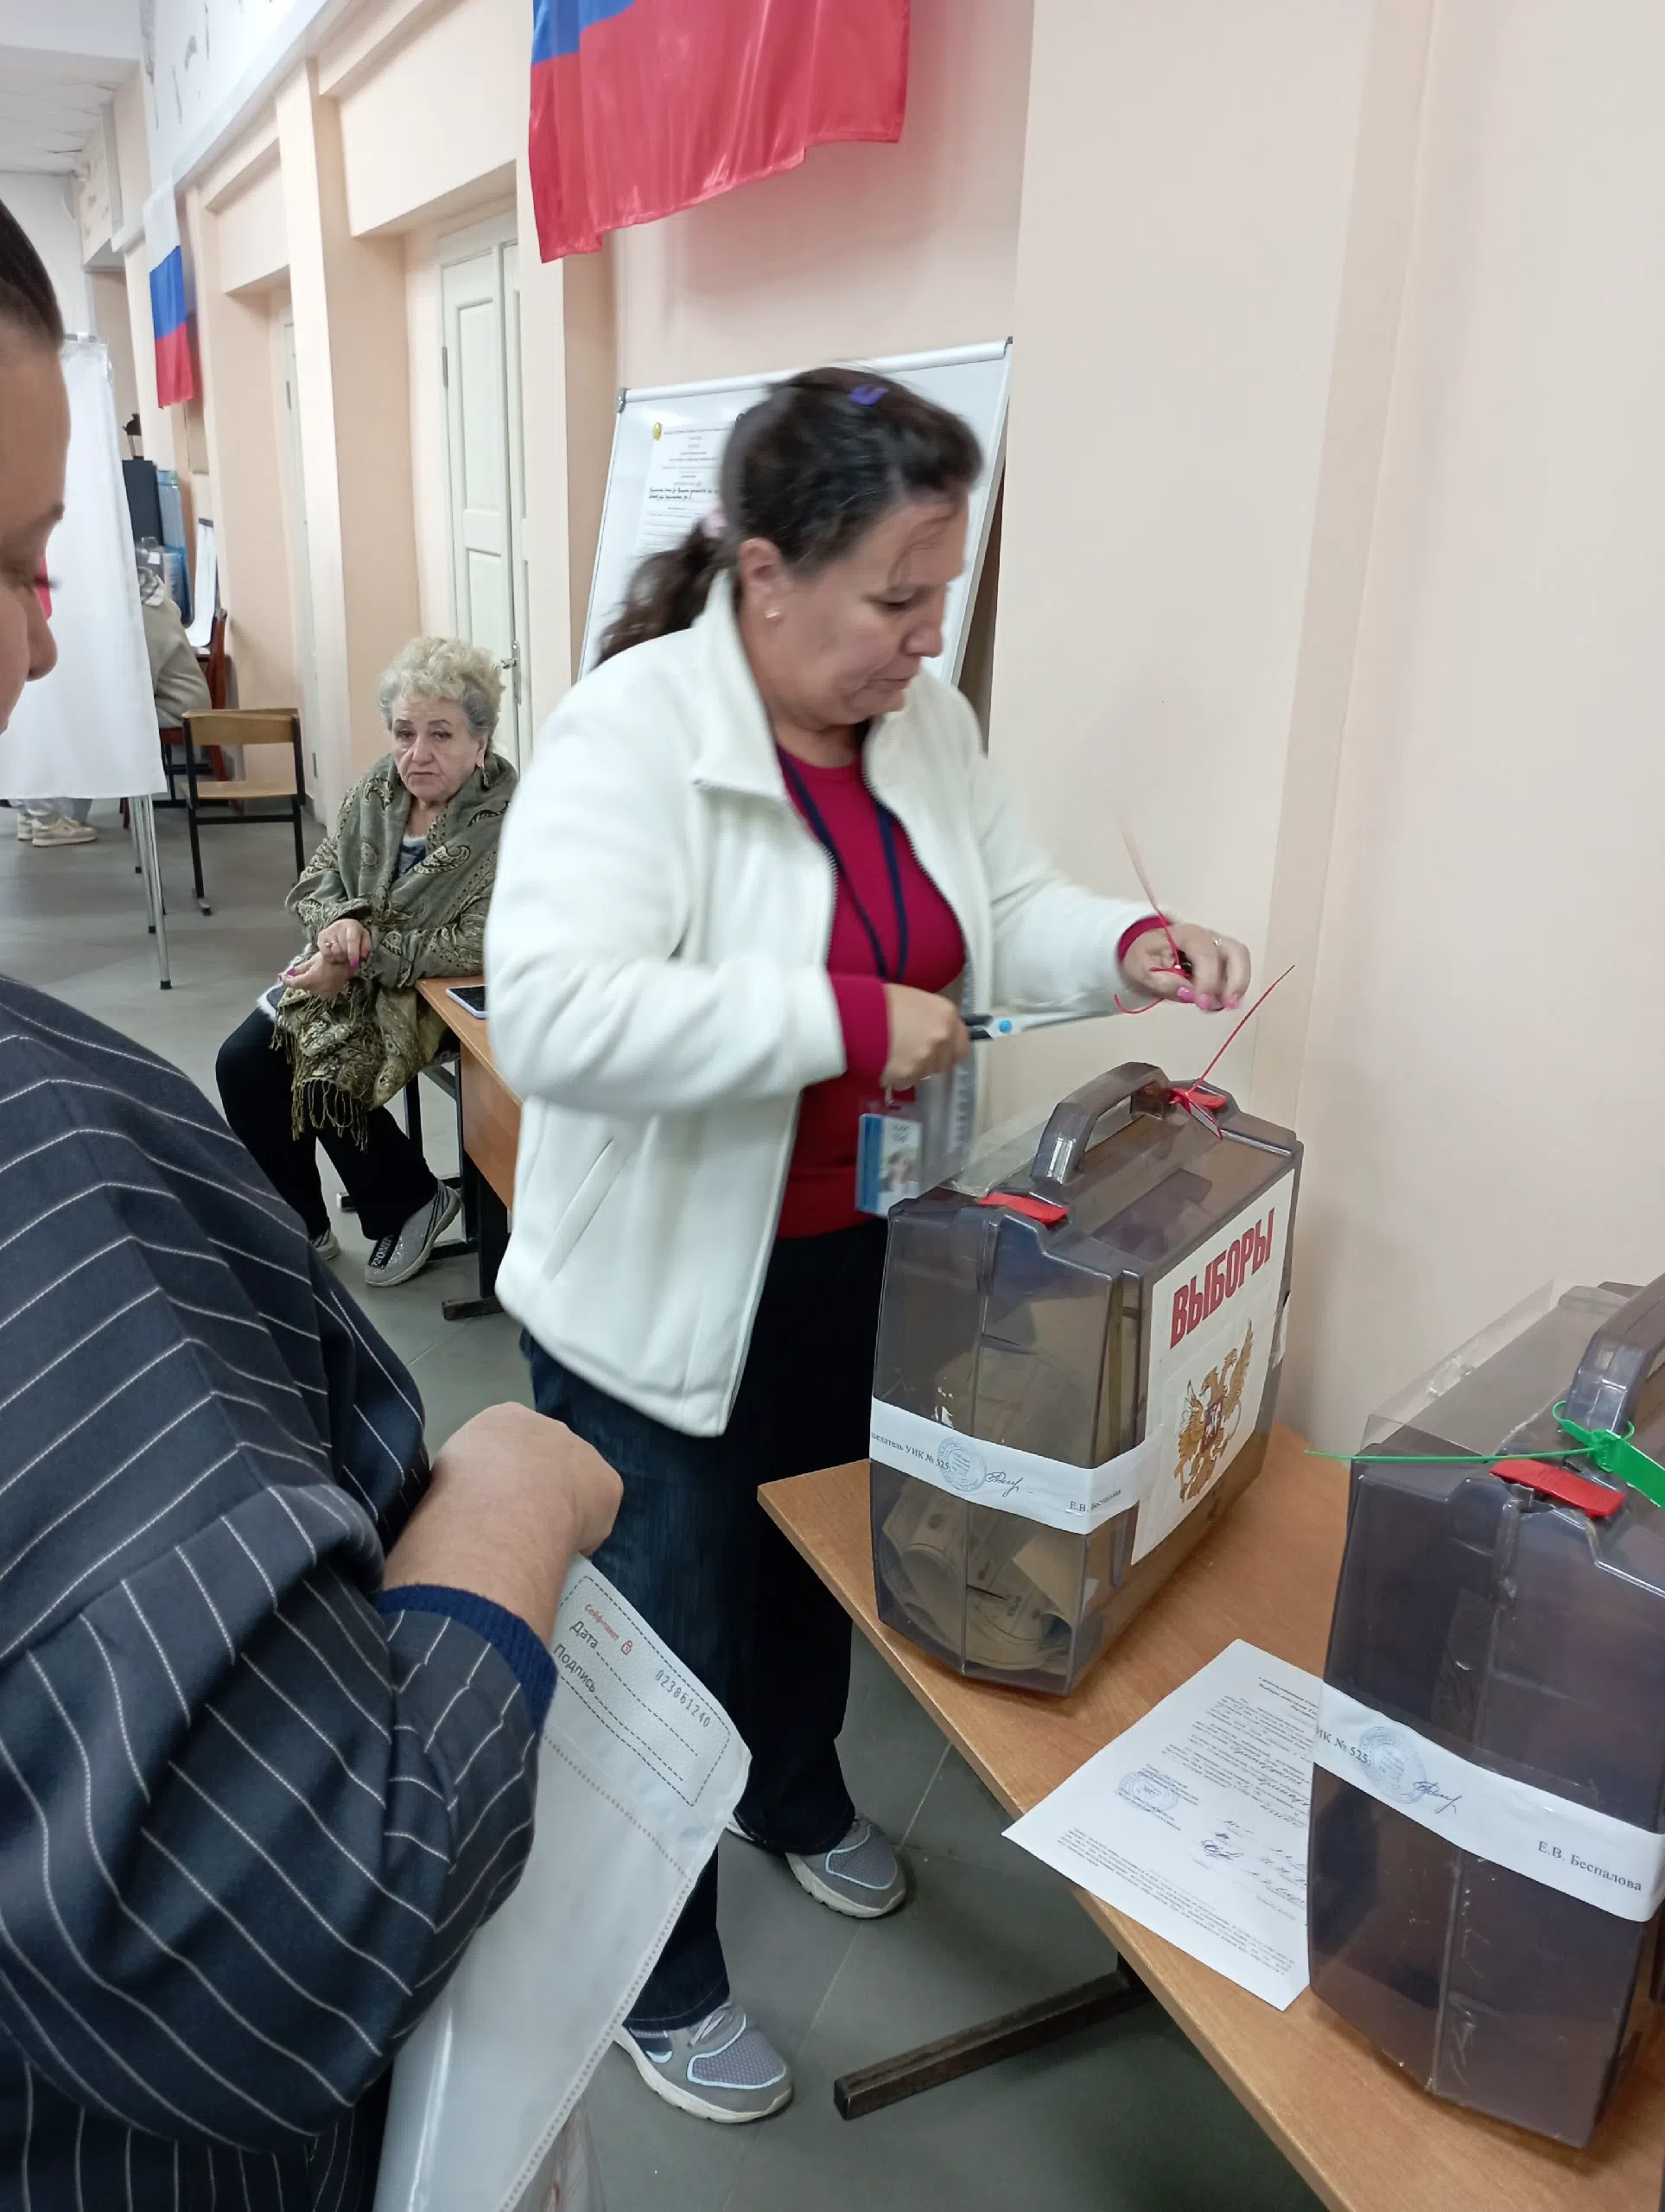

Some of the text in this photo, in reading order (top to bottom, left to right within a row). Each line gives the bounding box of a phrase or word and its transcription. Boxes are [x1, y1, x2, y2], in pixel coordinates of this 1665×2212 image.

[1170, 1207, 1274, 1350] ВЫБОРЫ
[905, 1445, 925, 1459] УИК
[569, 1620, 598, 1649] Дата
[553, 1643, 595, 1693] Подпись
[656, 1669, 710, 1727] 023861240
[1333, 1737, 1348, 1753] №
[1538, 1840, 1643, 1891] Е.В. Беспалова
